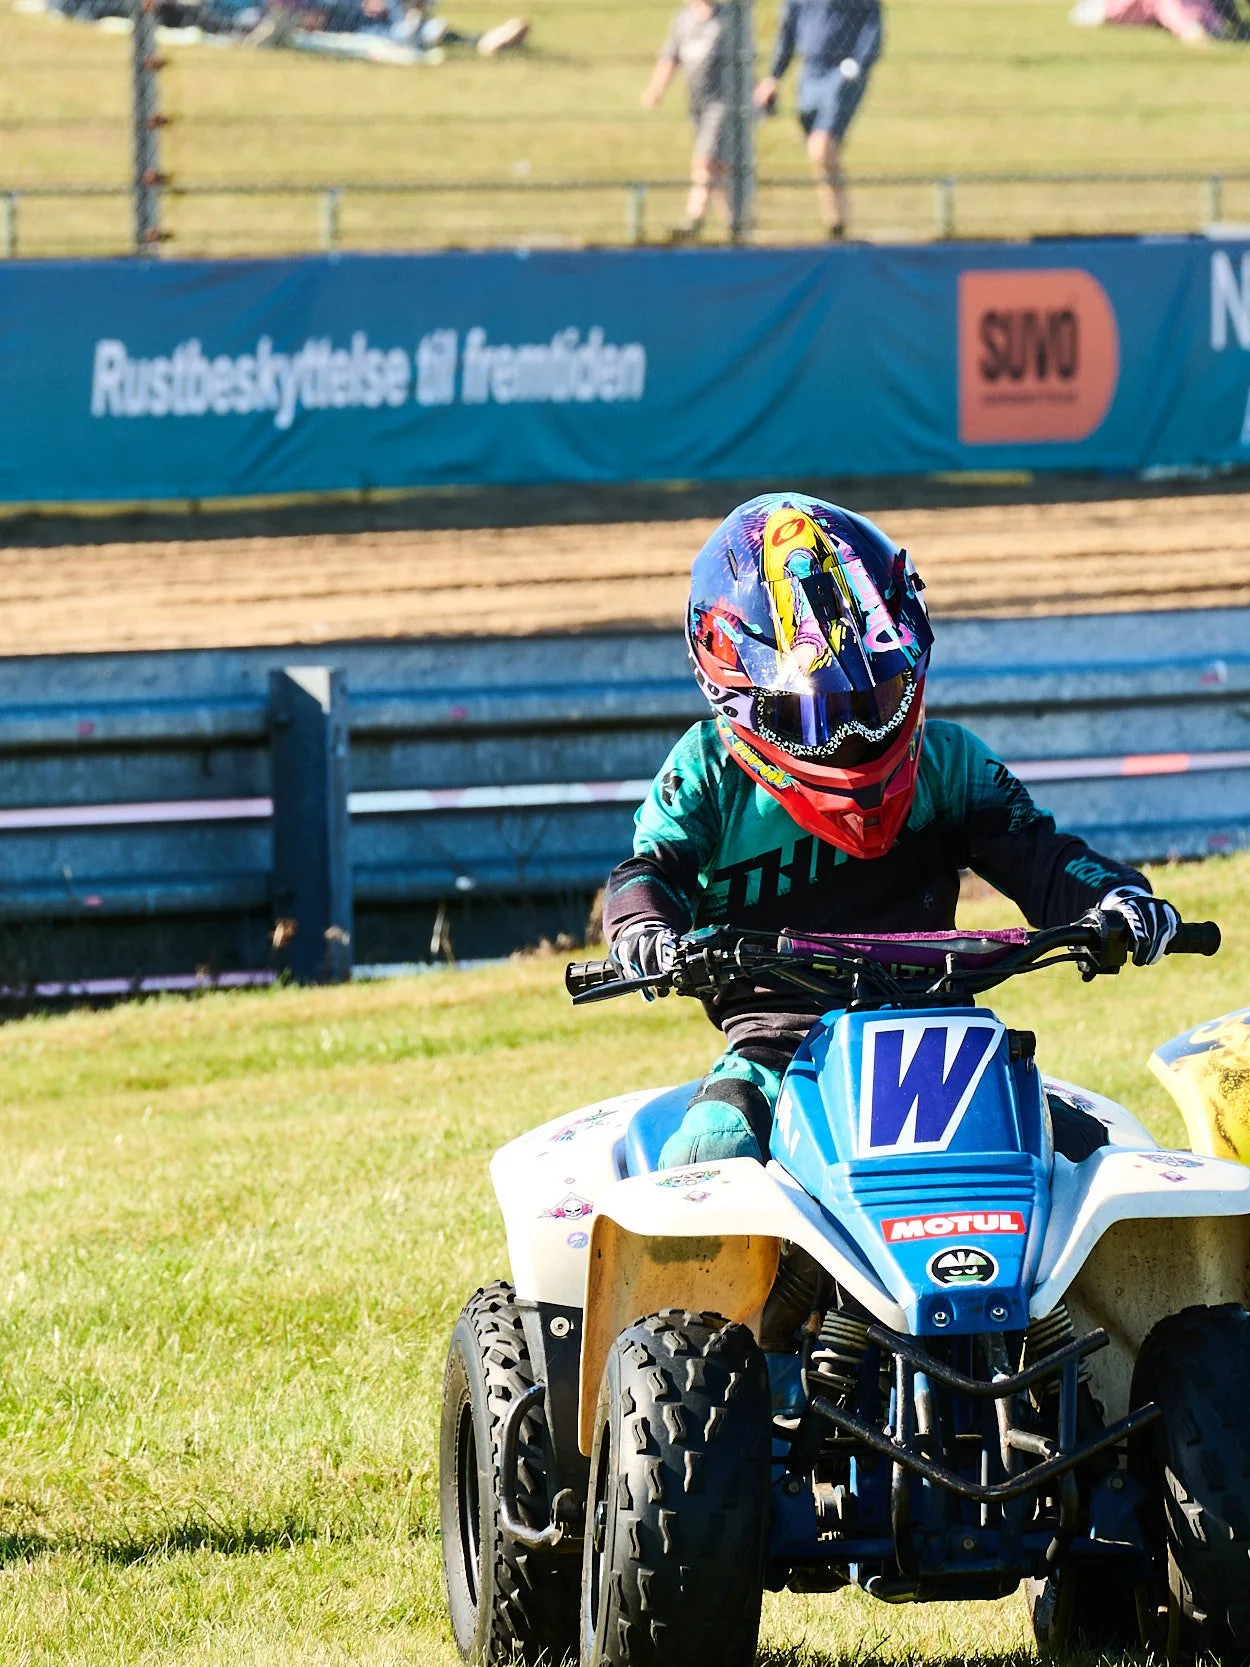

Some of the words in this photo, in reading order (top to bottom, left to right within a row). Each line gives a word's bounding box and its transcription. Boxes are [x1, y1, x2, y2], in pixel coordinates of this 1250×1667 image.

[92, 332, 411, 428] Rustbeskyttelse
[416, 328, 457, 405] til
[461, 327, 646, 402] fremtiden
[977, 305, 1081, 384] SUVO
[869, 1025, 996, 1148] W
[890, 1214, 1019, 1241] MOTUL
